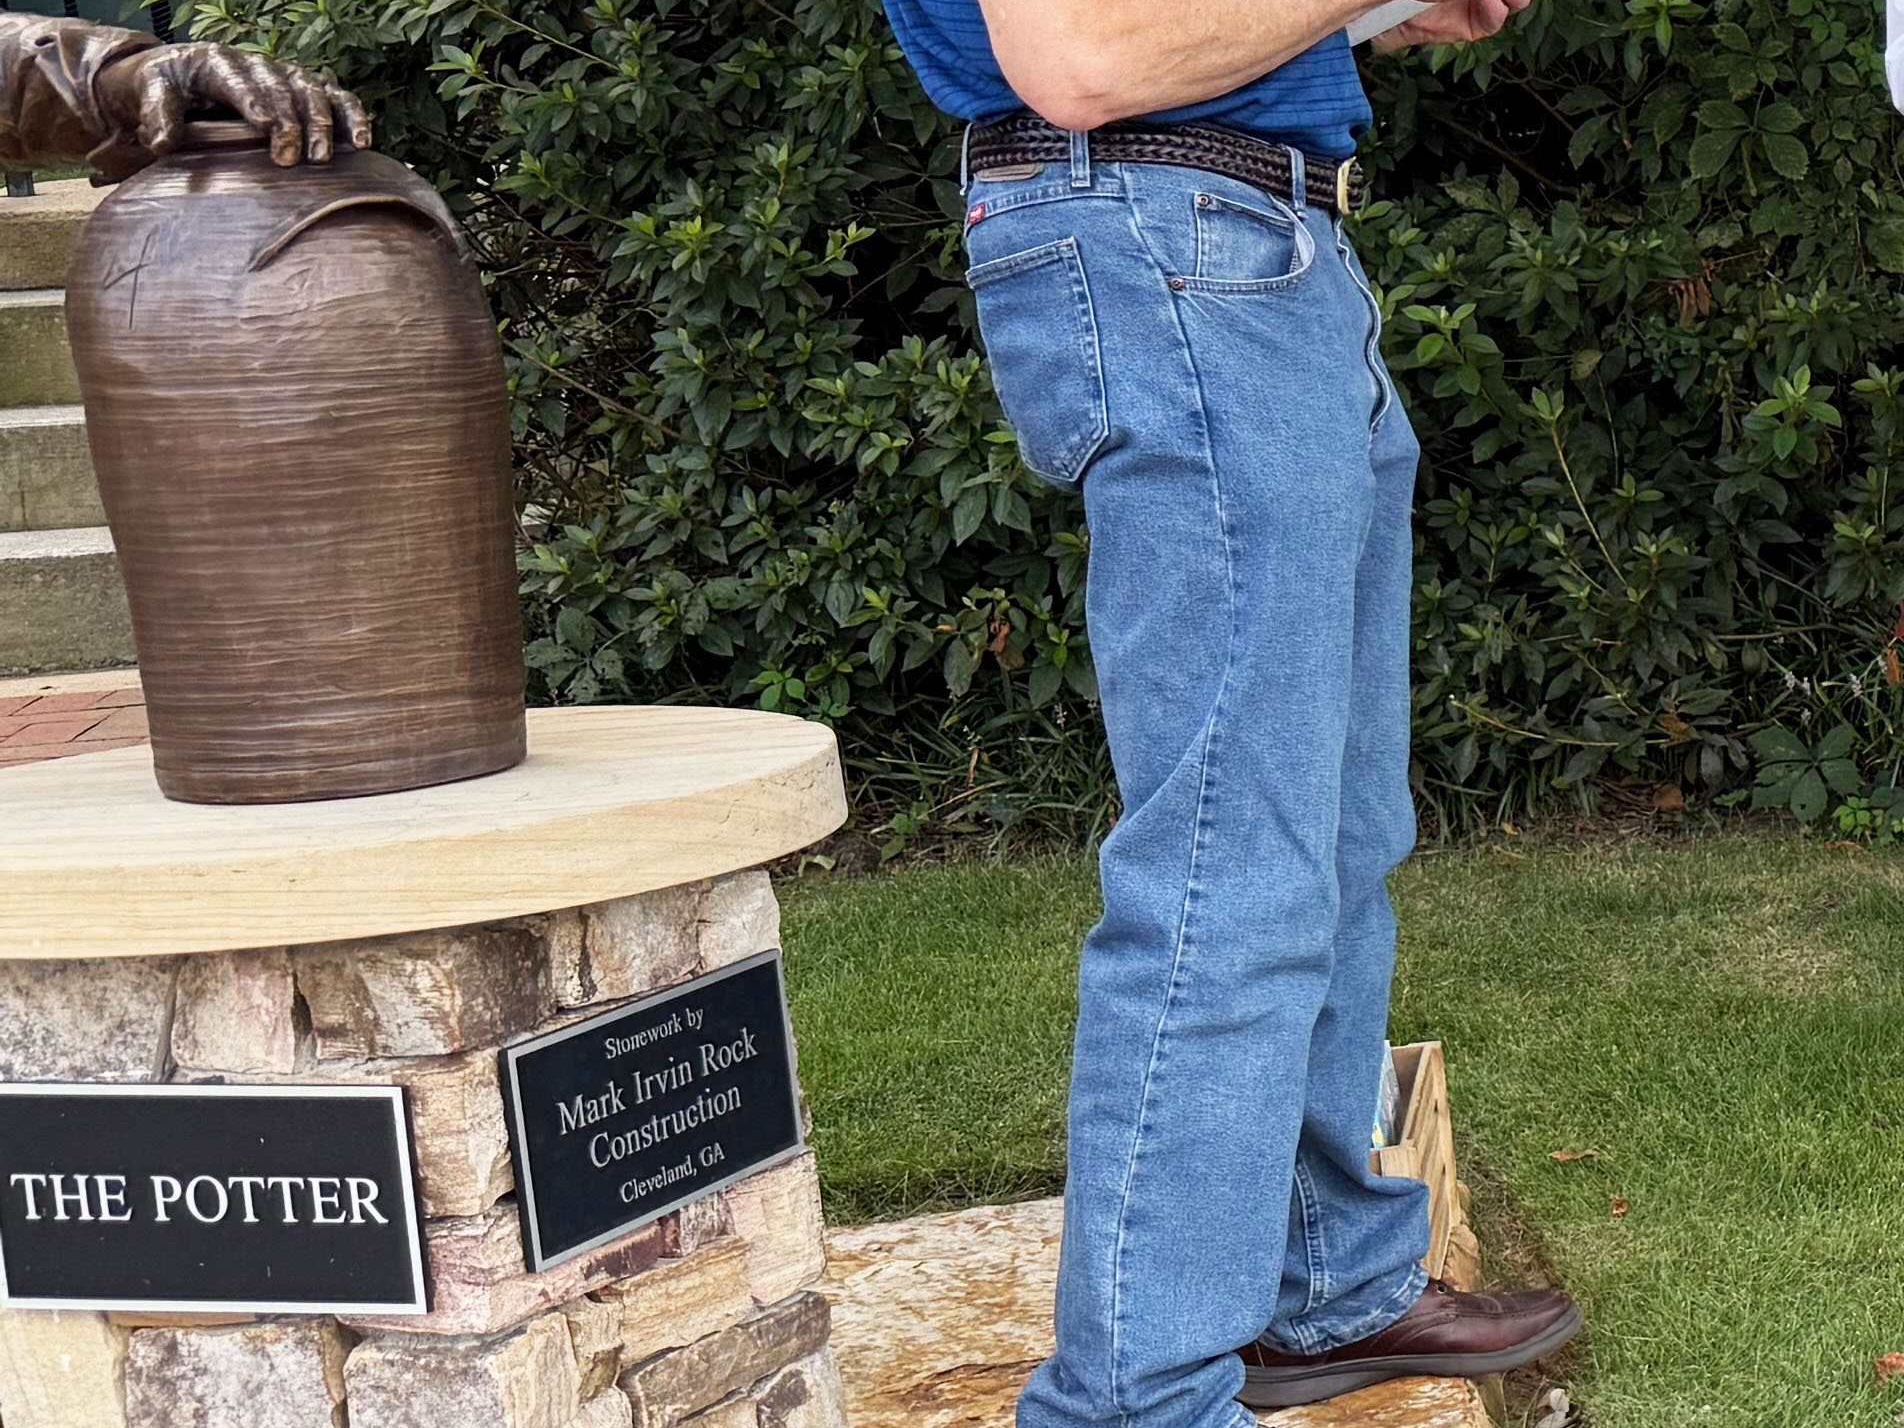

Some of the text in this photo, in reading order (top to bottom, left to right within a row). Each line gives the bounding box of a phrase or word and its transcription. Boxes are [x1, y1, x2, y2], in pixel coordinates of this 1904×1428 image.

[604, 1007, 704, 1059] Stonework by
[555, 1027, 758, 1135] Mark Irvin Rock
[589, 1086, 742, 1169] Construction
[9, 1173, 389, 1225] THE POTTER
[619, 1142, 726, 1204] Cleveland, GA
